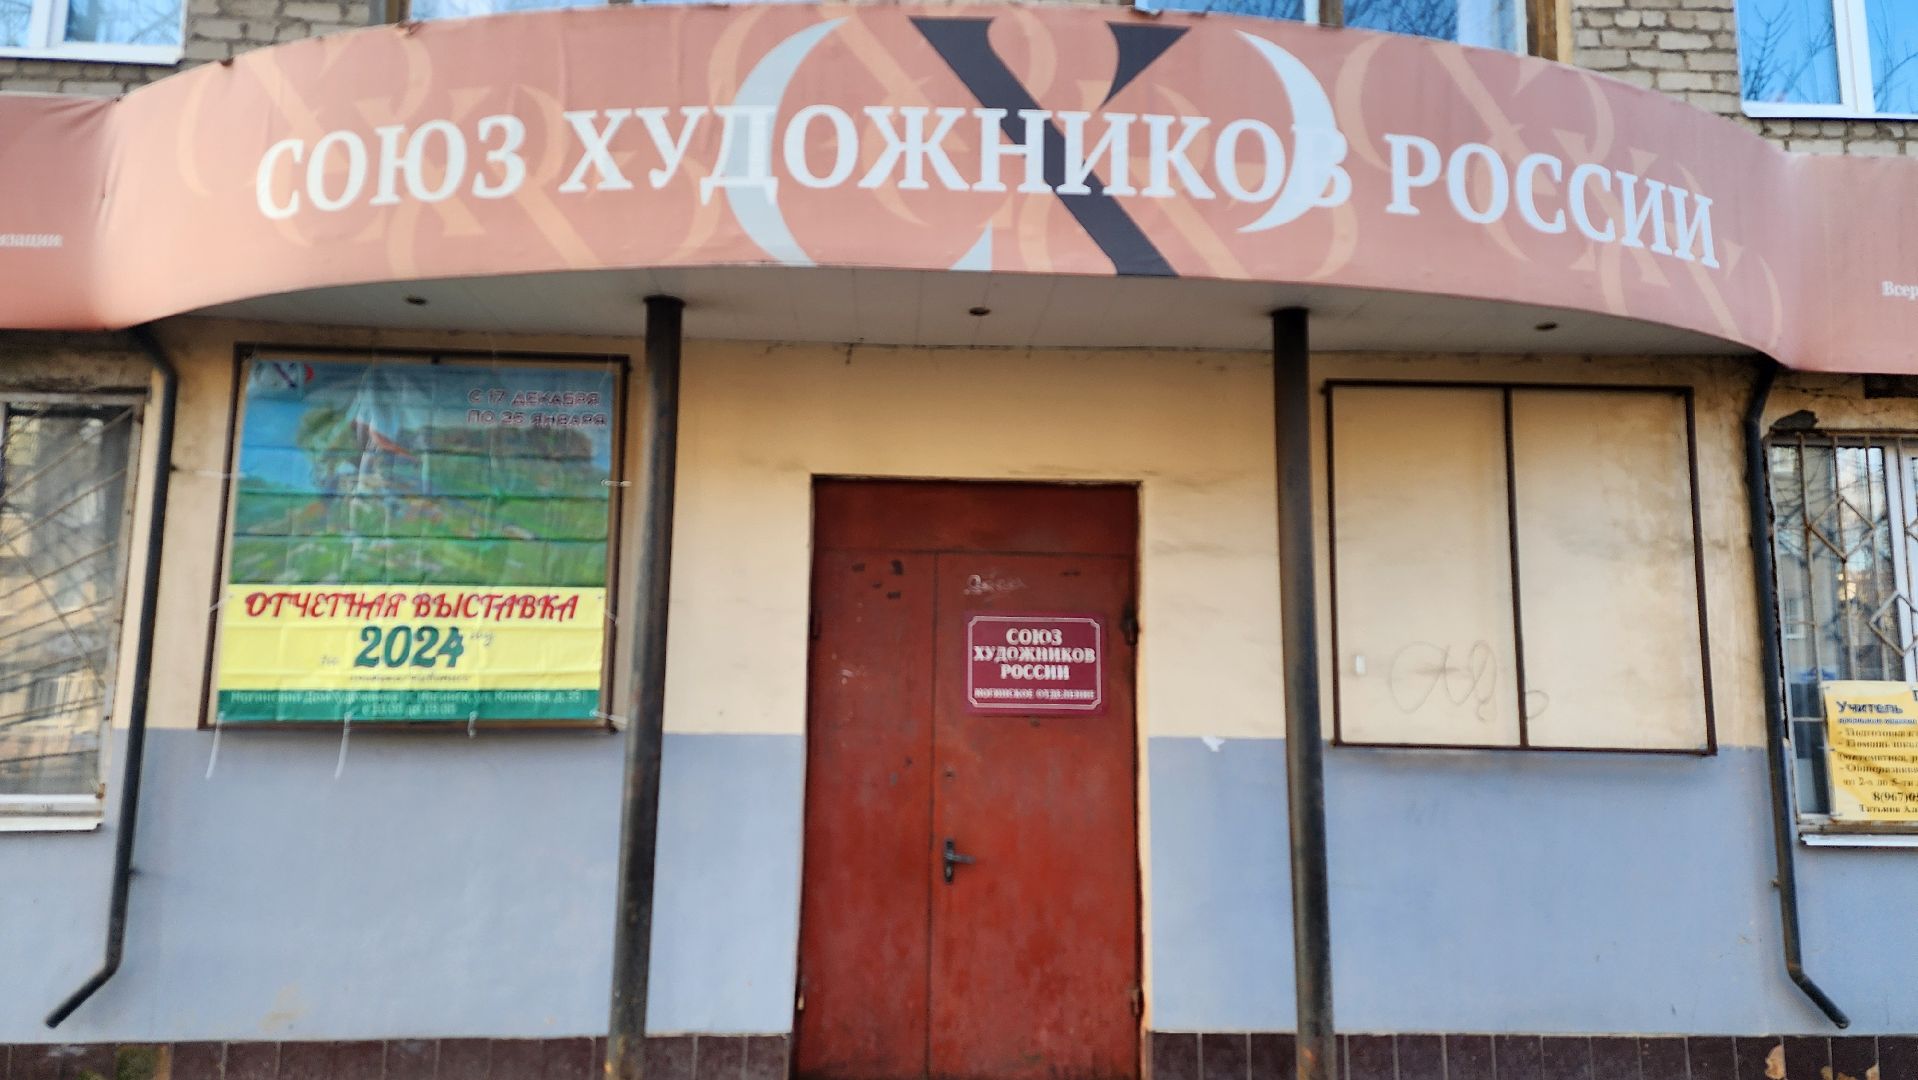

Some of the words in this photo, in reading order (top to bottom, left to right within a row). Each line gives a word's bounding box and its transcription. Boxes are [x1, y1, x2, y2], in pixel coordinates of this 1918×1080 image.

[256, 114, 527, 220] СОЮЗ
[558, 102, 1353, 209] ХУДОЖНИКОВ
[1383, 133, 1720, 269] РОССИИ
[488, 388, 505, 404] 17
[511, 391, 601, 407] ДЕКАБРЯ
[468, 409, 496, 425] ПО
[529, 412, 608, 427] ЯНВАРЯ
[244, 591, 407, 620] ОТЧЕТНАЯ
[411, 592, 580, 622] ВЫСТАВКА
[1005, 627, 1063, 646] СОЮЗ
[354, 625, 465, 668] 2024
[973, 645, 1096, 664] ХУДОЖНИКОВ
[1000, 663, 1071, 681] РОССИИ
[1036, 688, 1096, 701] ОТДЕЛЕНИЕ
[1836, 700, 1904, 714] Учитель
